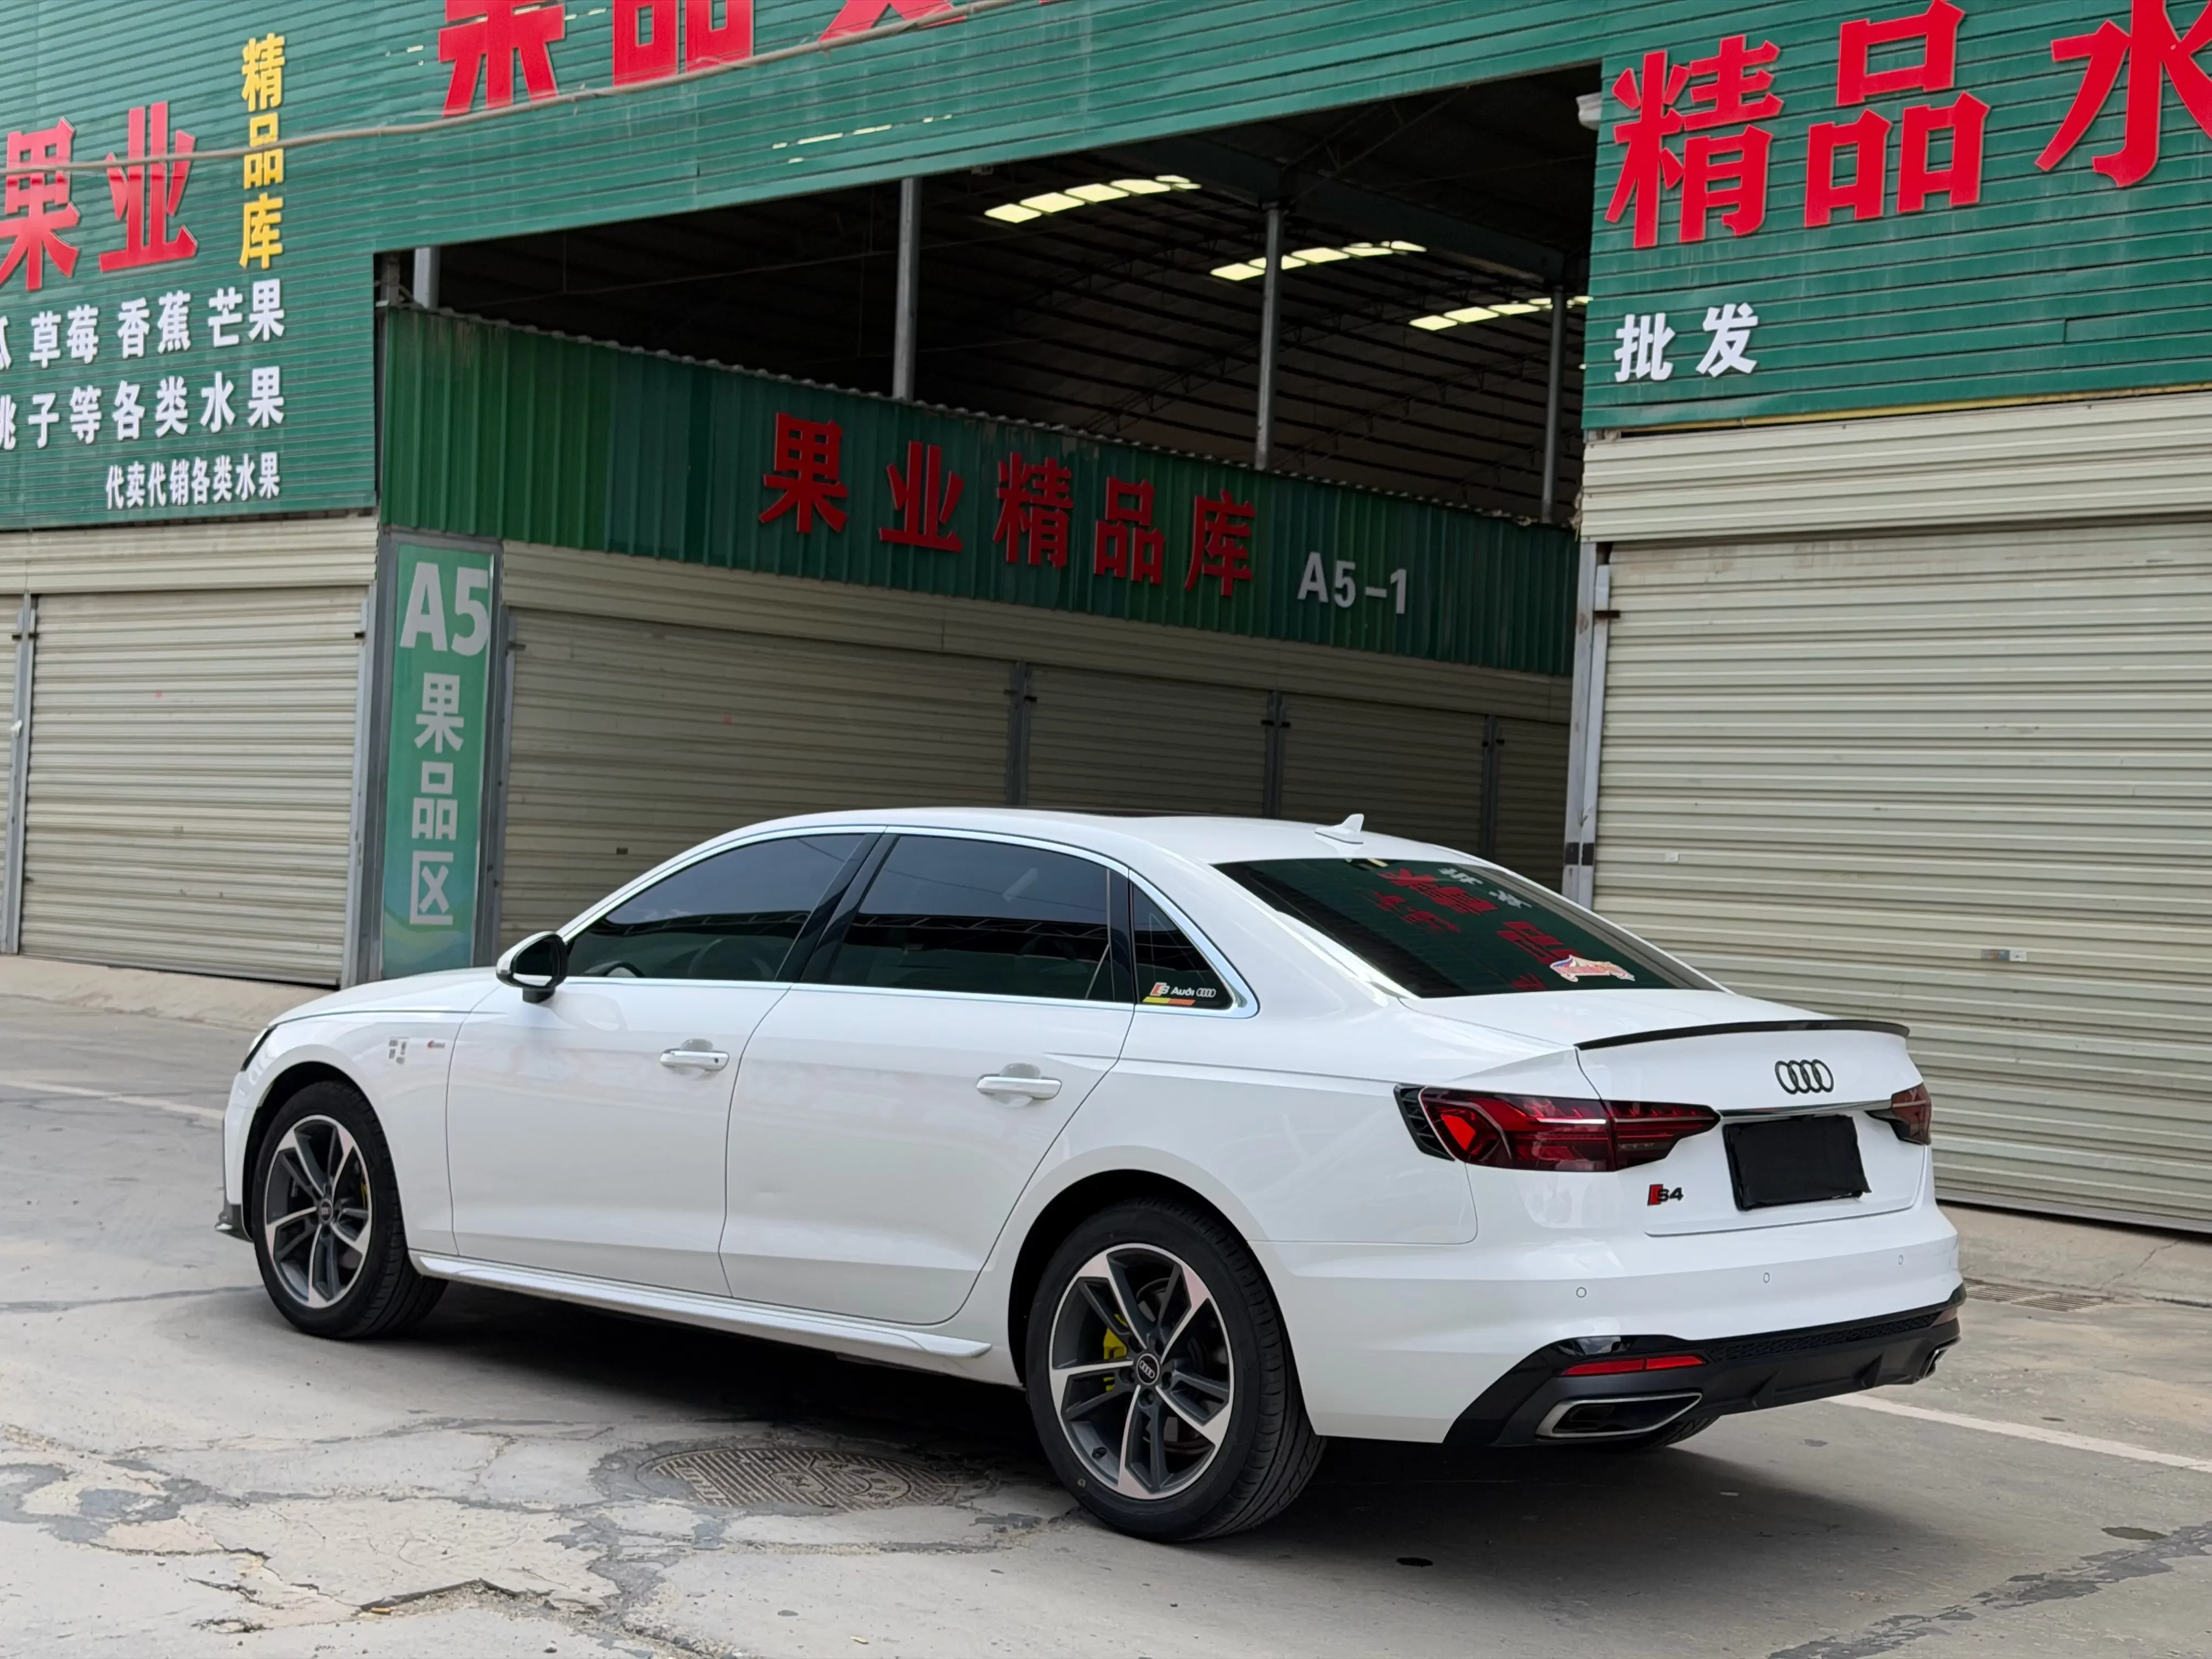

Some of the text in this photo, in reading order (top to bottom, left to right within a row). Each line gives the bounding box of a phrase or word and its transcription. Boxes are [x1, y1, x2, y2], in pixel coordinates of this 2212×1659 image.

[0, 101, 198, 291] 果业
[239, 33, 285, 269] 精品库
[29, 304, 99, 369] 草莓
[117, 290, 191, 359] 香蕉
[208, 278, 285, 348] 芒果
[1613, 302, 1759, 382] 批发
[106, 452, 281, 510] 代卖代销各类水果
[759, 412, 1408, 616] 果业精品库 A5-1
[399, 562, 489, 656] A5
[410, 673, 464, 925] 果品区
[1171, 986, 1195, 996] Audi
